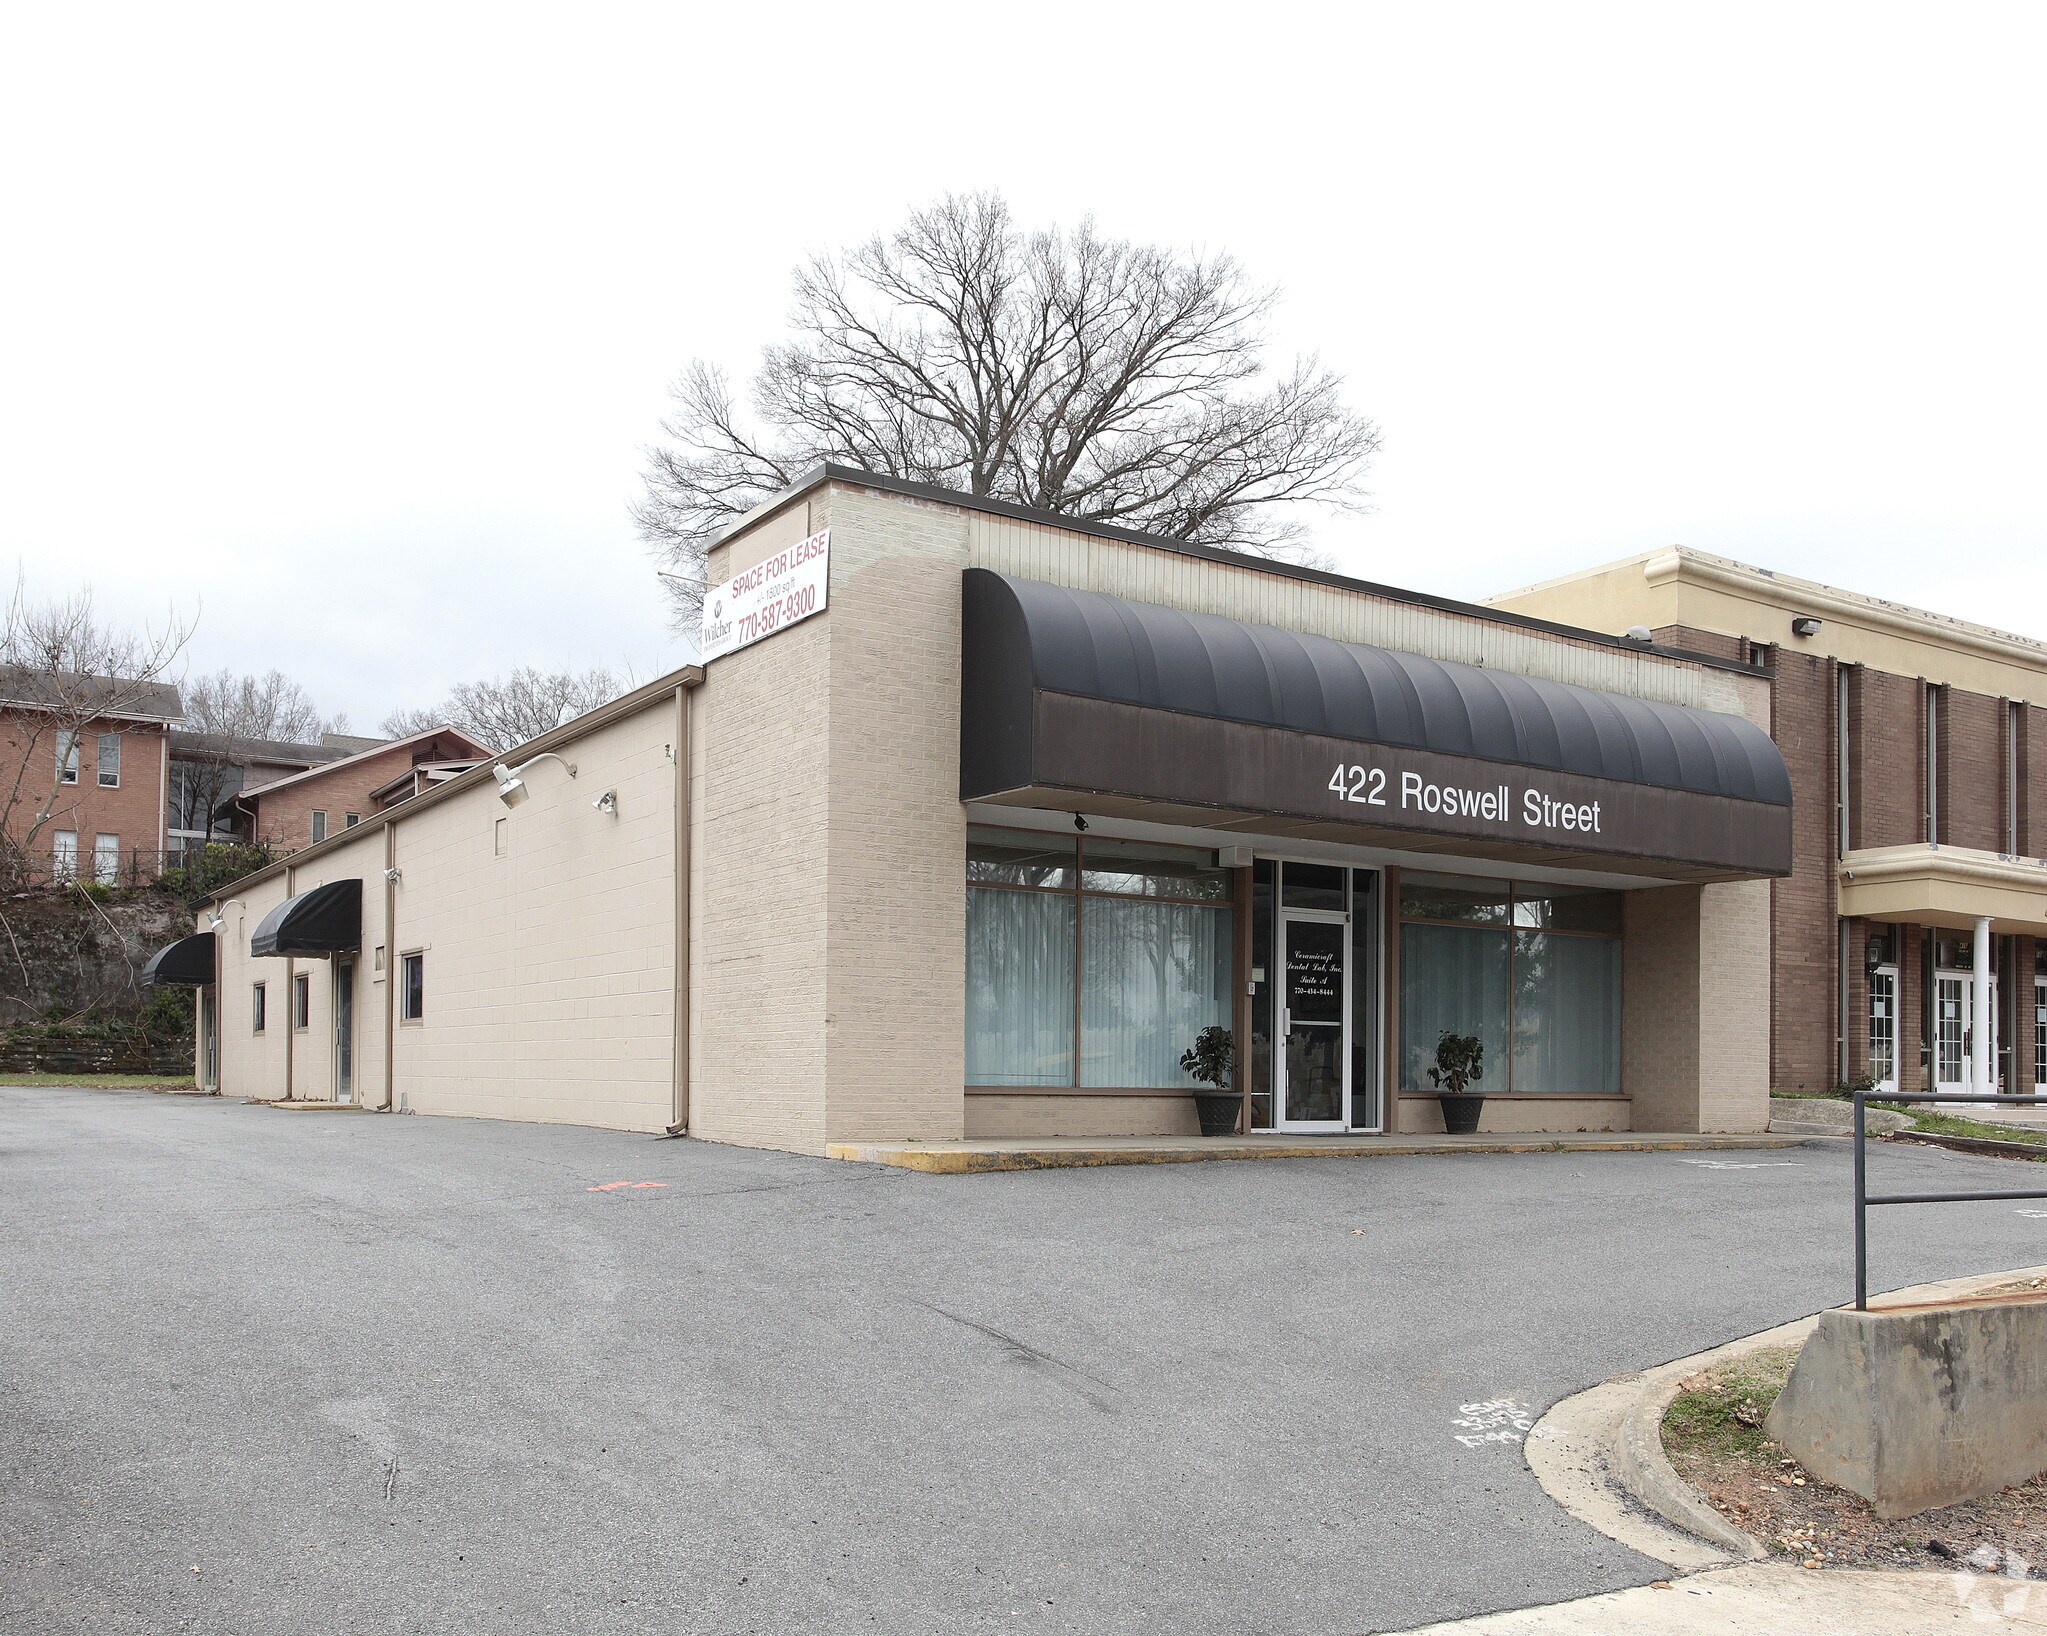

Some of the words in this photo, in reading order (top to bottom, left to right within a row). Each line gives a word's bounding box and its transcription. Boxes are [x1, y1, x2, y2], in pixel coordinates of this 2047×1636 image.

[732, 566, 763, 599] SPACE
[766, 553, 787, 581] FOR
[790, 533, 826, 569] LEASE
[738, 584, 815, 643] 770-587-9300
[704, 620, 732, 644] Wilcher
[1328, 763, 1386, 806] 422
[1401, 771, 1509, 822] Roswell
[1523, 788, 1600, 833] Street
[1286, 961, 1309, 970] Dental
[1312, 962, 1327, 972] Lab,
[1329, 964, 1342, 973] Inc.
[1294, 949, 1334, 963] Ceramicraft
[1300, 975, 1317, 984] Suite
[1319, 976, 1328, 985] A
